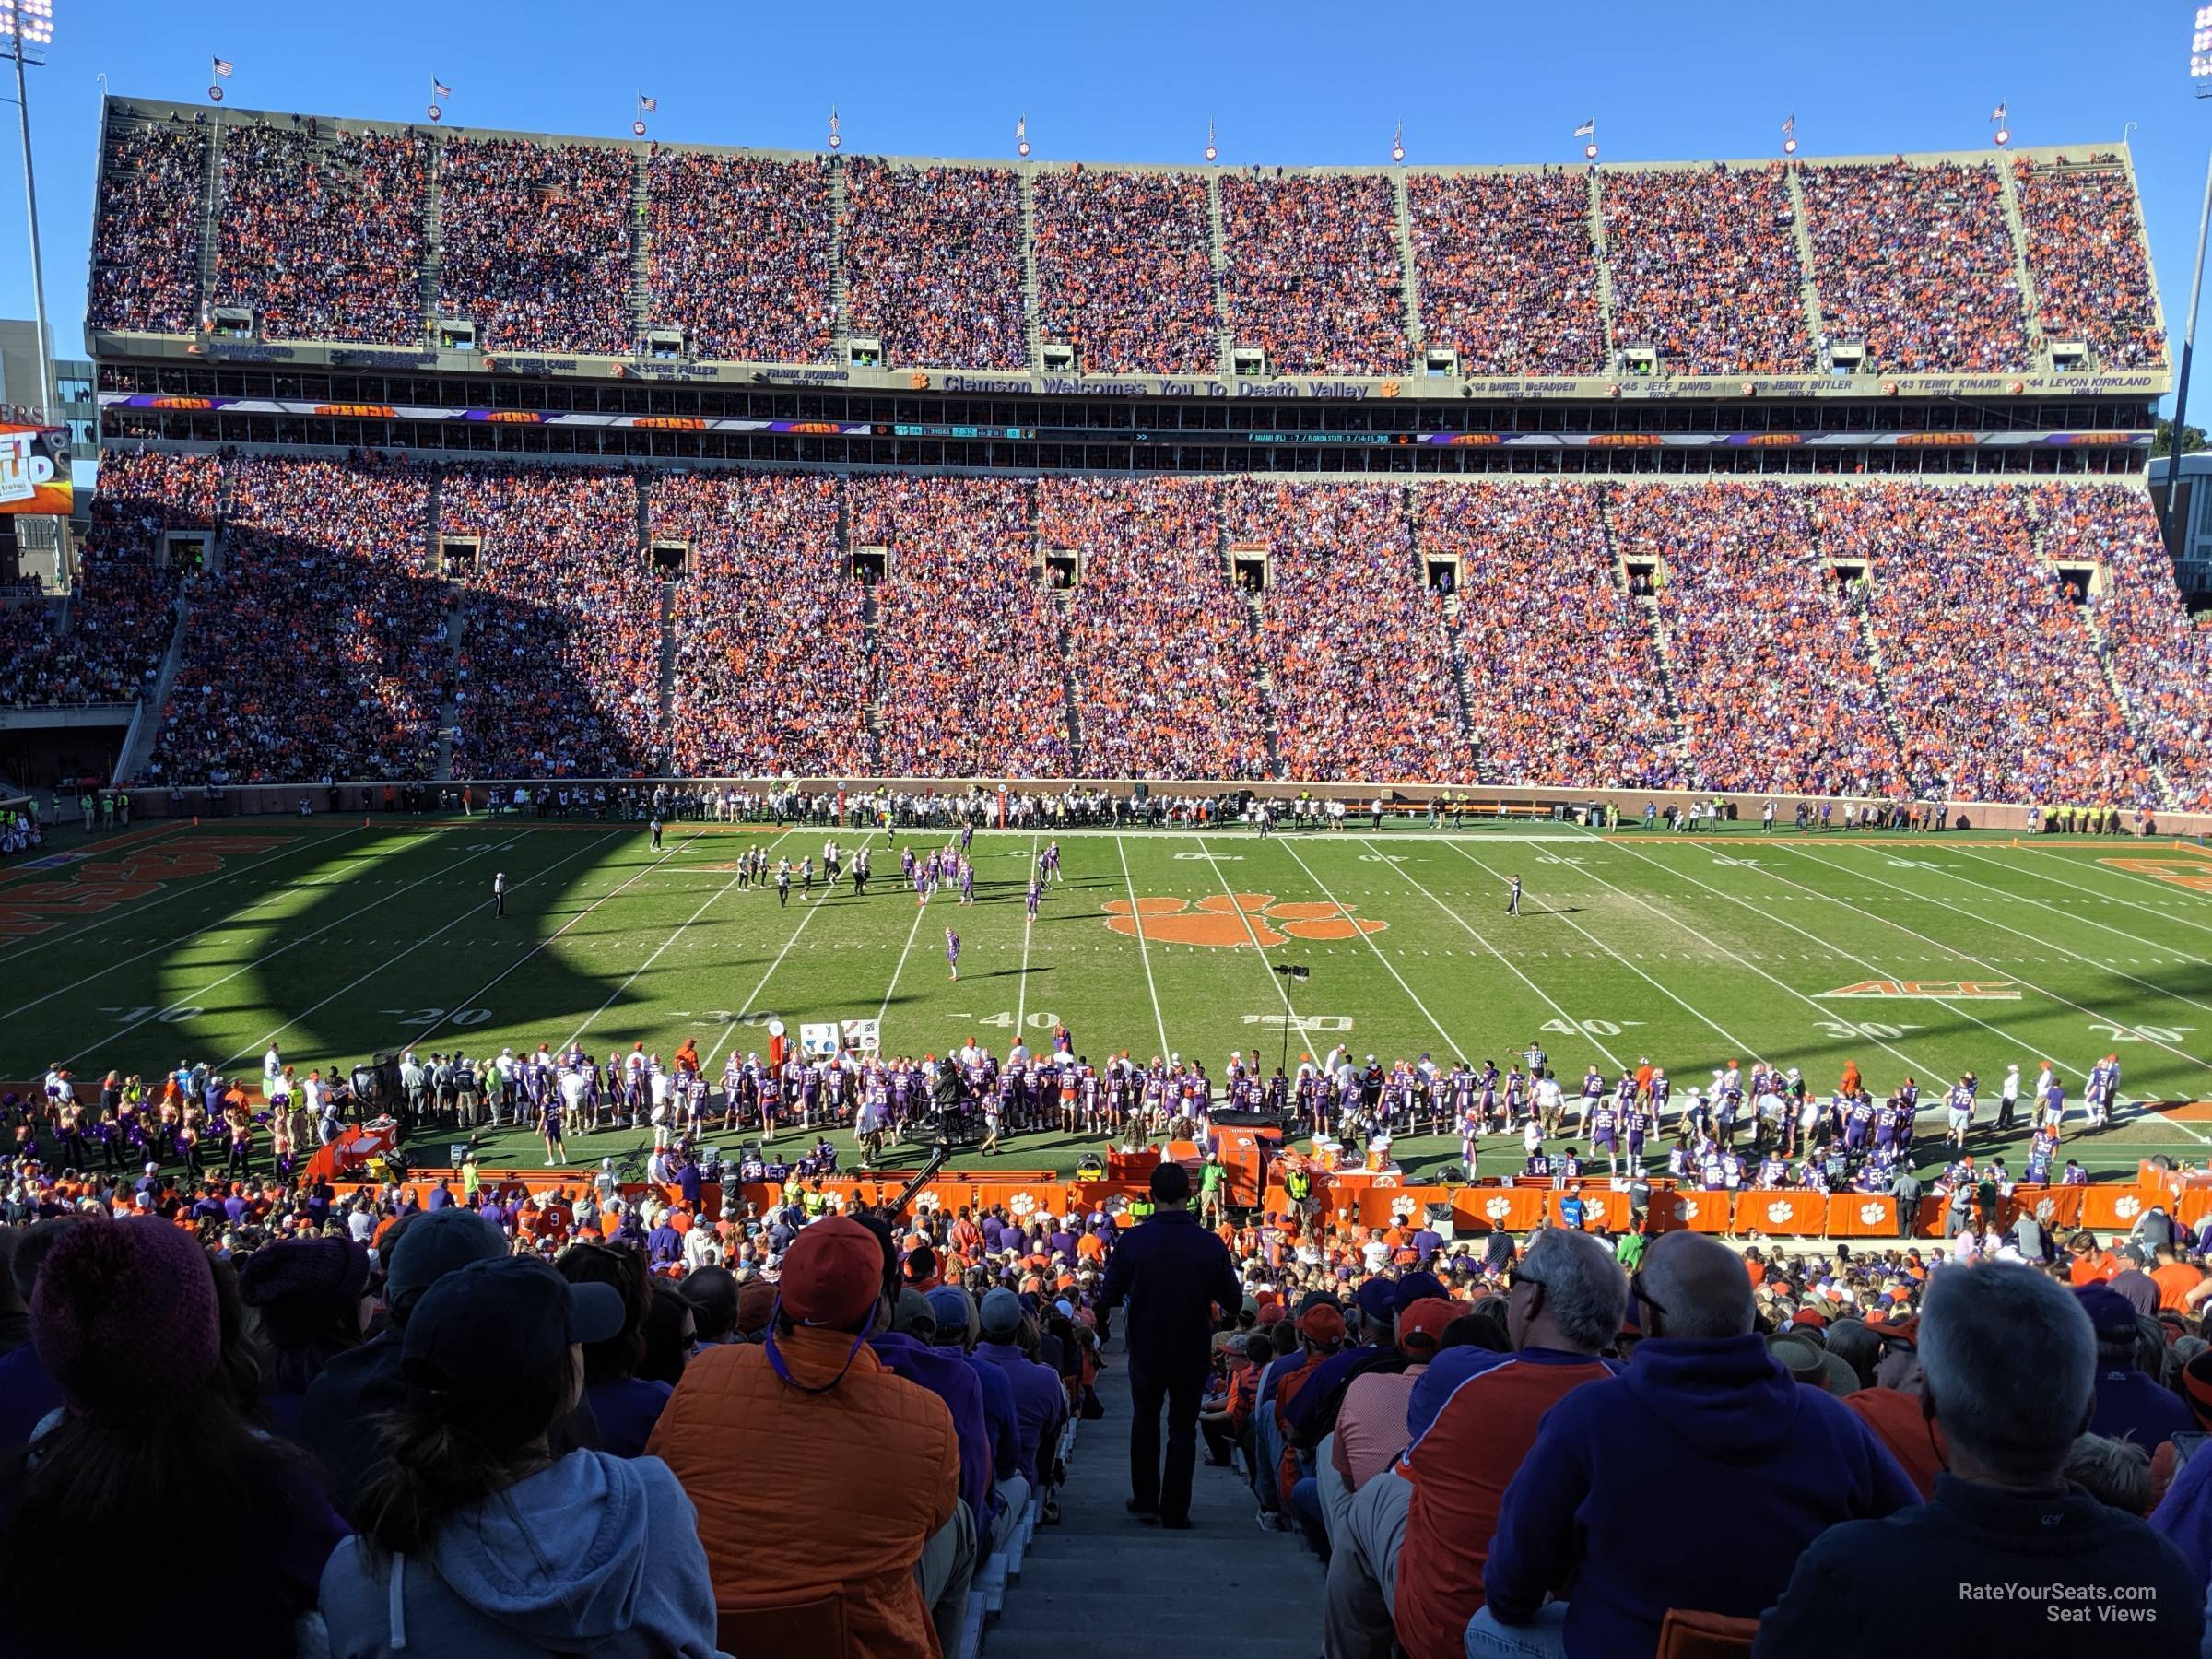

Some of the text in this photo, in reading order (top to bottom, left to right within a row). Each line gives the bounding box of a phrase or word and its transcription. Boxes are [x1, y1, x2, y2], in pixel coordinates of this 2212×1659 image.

[642, 364, 675, 373] STEVE
[678, 365, 718, 375] FULLER
[767, 369, 849, 380] FRANK HOWARD
[943, 375, 1368, 401] Clemson Welcomes You To Death Valley
[1488, 382, 1520, 391] BANKS
[1525, 382, 1576, 391] McFADDEN
[1645, 382, 1673, 391] JEFF
[1678, 382, 1712, 391] DAVIS
[1773, 381, 1806, 390] JERRY
[1810, 381, 1852, 390] BUTLER
[1919, 380, 1954, 389] TERRY
[1959, 379, 2001, 388] KINARD
[2049, 378, 2088, 387] LEVON
[2090, 376, 2152, 387] KIRKLAND
[956, 428, 974, 436] 7:32
[1274, 434, 1286, 442] (FL)
[1823, 980, 2021, 997] ACC
[118, 1006, 205, 1023] 10
[398, 1008, 493, 1025] 20
[691, 1010, 780, 1027] 30
[979, 1011, 1060, 1029] 40
[1539, 1018, 1622, 1036] 40
[1813, 1022, 1903, 1039] 30
[2088, 1025, 2183, 1042] 20
[1955, 1091, 1972, 1105] 72
[1534, 1160, 1548, 1174] 14
[550, 1212, 560, 1226] 9
